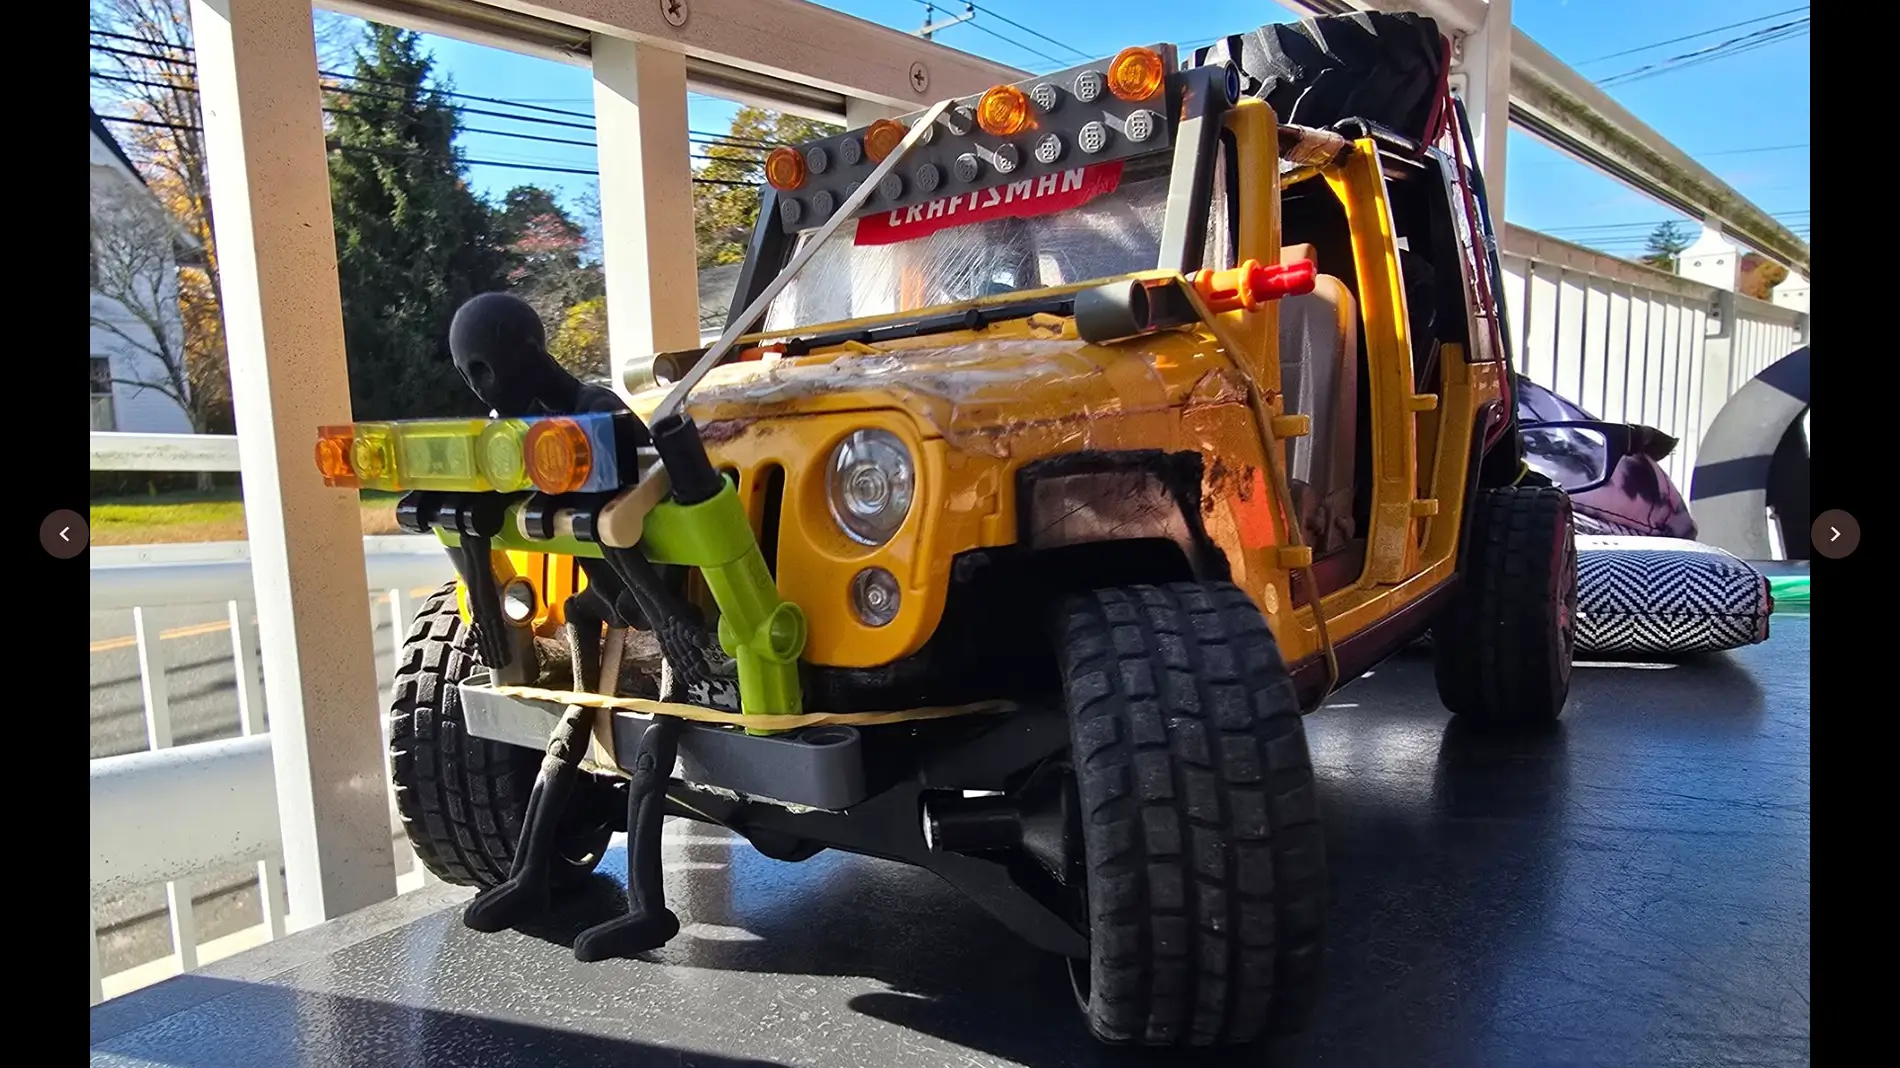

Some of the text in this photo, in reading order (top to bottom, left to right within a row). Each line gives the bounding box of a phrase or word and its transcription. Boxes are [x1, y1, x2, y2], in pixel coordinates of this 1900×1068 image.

[1080, 75, 1097, 99] LEGO
[1084, 126, 1101, 150] LEGO
[1131, 114, 1148, 139] LEGO
[888, 167, 1085, 227] CRAFTSMAN
